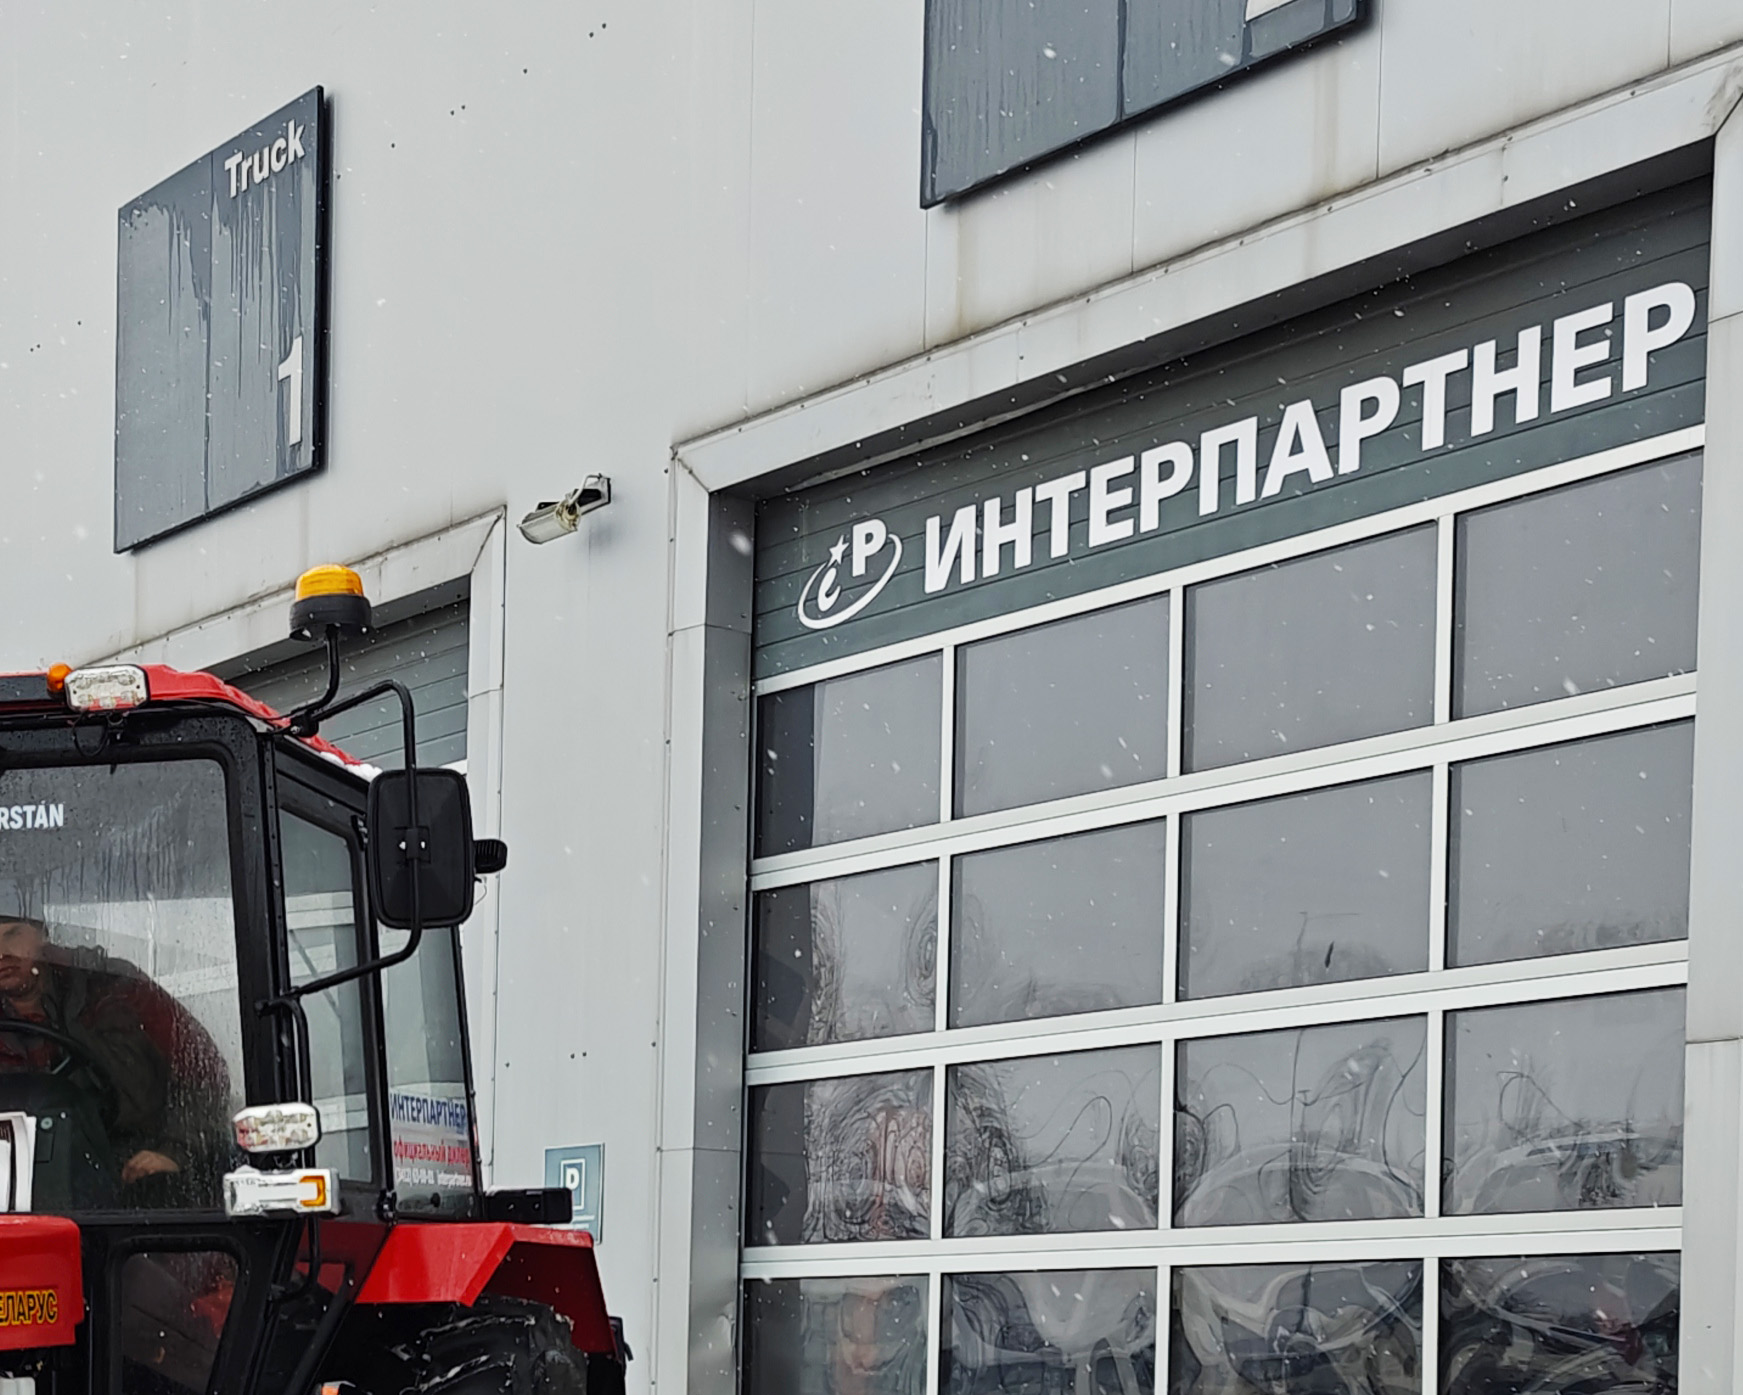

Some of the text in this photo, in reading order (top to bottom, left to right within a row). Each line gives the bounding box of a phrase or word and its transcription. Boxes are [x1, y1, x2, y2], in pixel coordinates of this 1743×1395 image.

[224, 119, 305, 199] Truck
[278, 333, 304, 448] 1
[922, 281, 1698, 596] ИНТЕРПАРТНЕР
[390, 1093, 467, 1128] ИНТЕРПАРТНЕР
